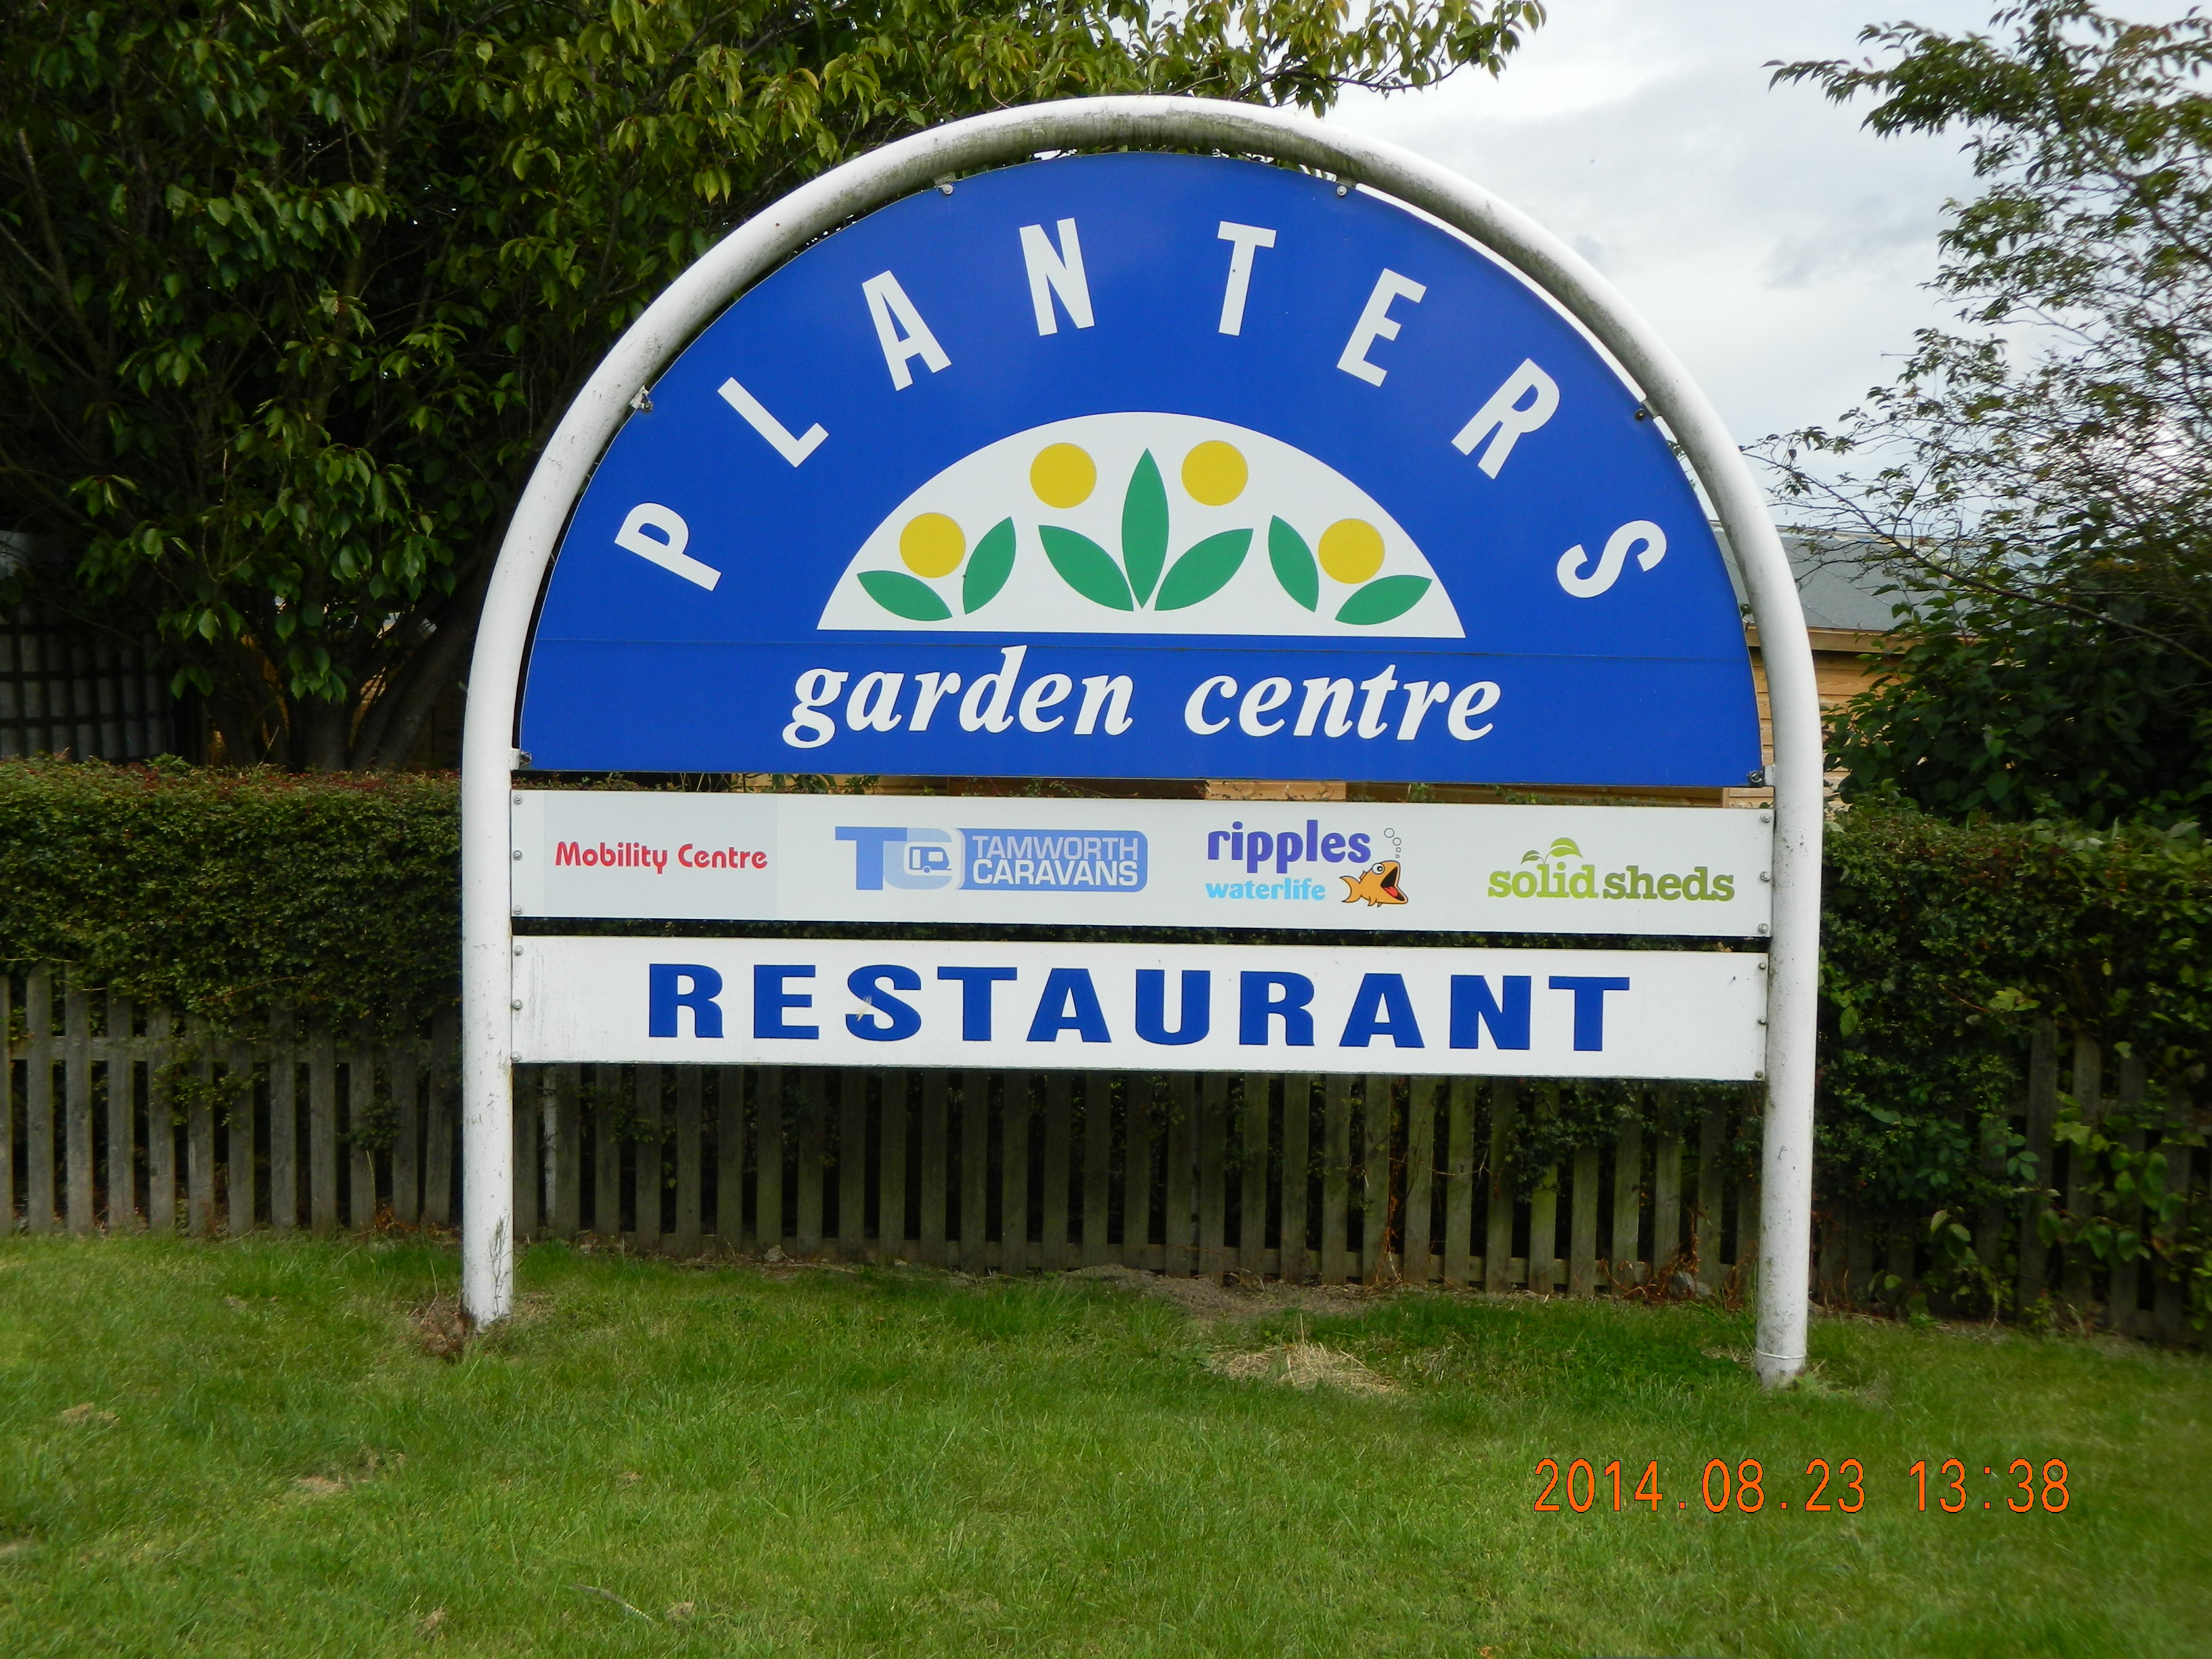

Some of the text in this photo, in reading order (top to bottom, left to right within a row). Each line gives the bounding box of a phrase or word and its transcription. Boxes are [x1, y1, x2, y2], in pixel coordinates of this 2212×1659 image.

[615, 218, 1667, 599] PLANTERS
[781, 644, 1501, 748] garden centre
[555, 841, 768, 875] Mobility Centre
[971, 835, 1138, 861] TAMWORTH
[1208, 819, 1371, 874] ripples
[972, 859, 1138, 886] CARAVANS
[1206, 877, 1326, 901] waterlife
[1488, 862, 1736, 902] solid sheds
[648, 962, 1630, 1052] RESTAURANT
